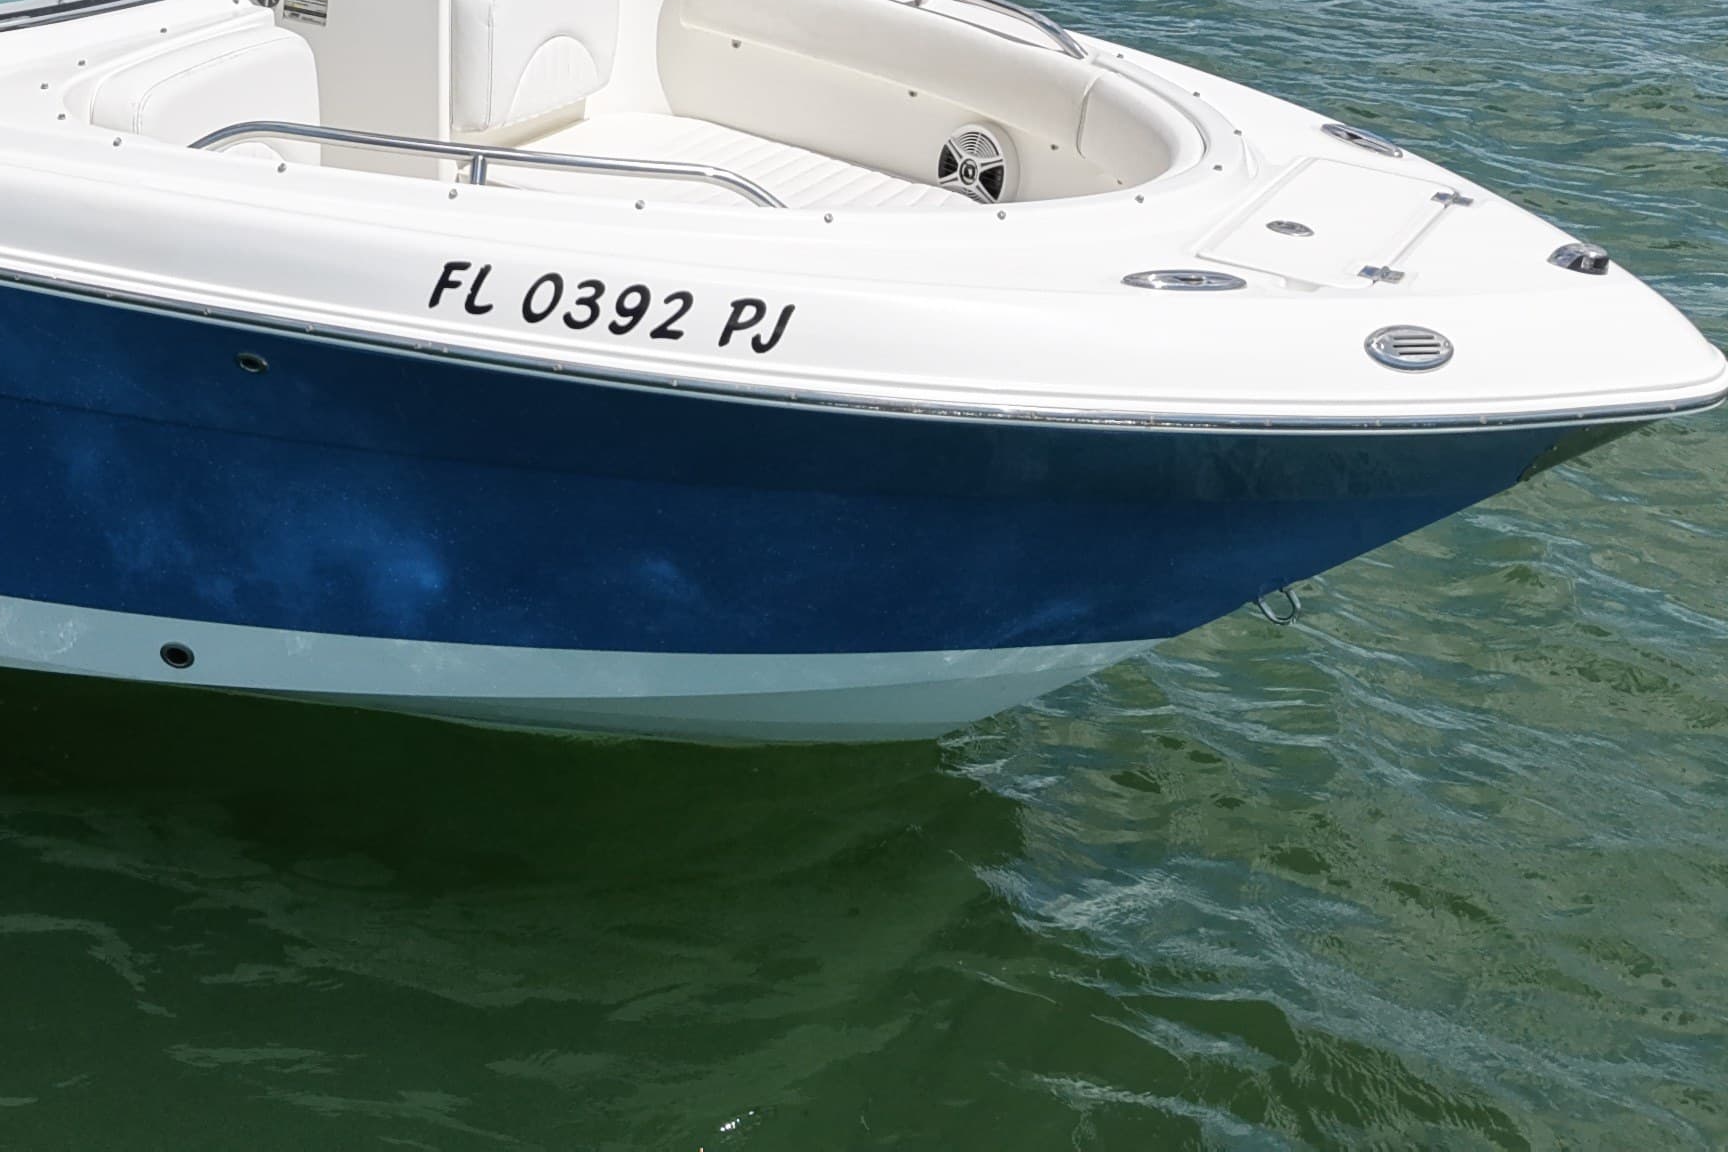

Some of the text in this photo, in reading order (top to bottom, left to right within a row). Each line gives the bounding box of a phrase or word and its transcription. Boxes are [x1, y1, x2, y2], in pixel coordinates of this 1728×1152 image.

[428, 261, 796, 354] FL 0392 PJ
